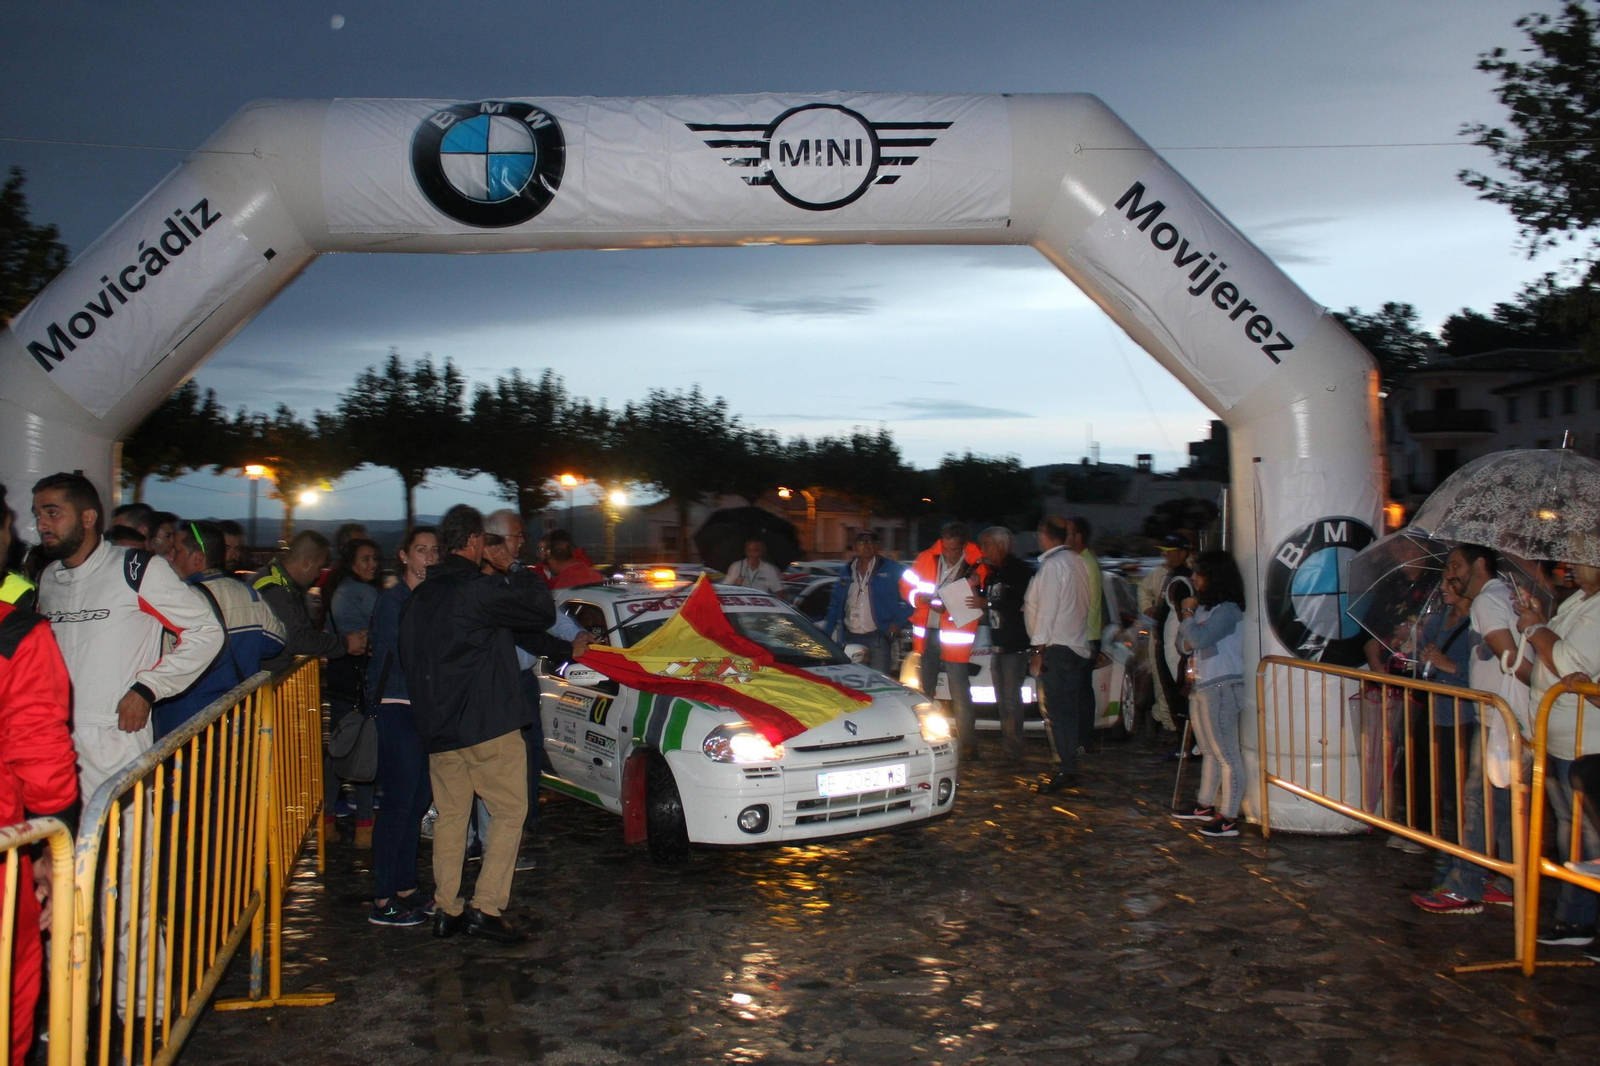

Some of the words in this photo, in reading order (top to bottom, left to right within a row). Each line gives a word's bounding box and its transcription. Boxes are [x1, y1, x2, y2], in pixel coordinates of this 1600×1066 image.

[429, 102, 552, 130] BMW
[779, 138, 863, 167] MINI
[26, 198, 222, 373] Movicádiz
[1114, 180, 1295, 365] Movijerez
[594, 697, 608, 724] 0
[846, 770, 880, 790] 2082
